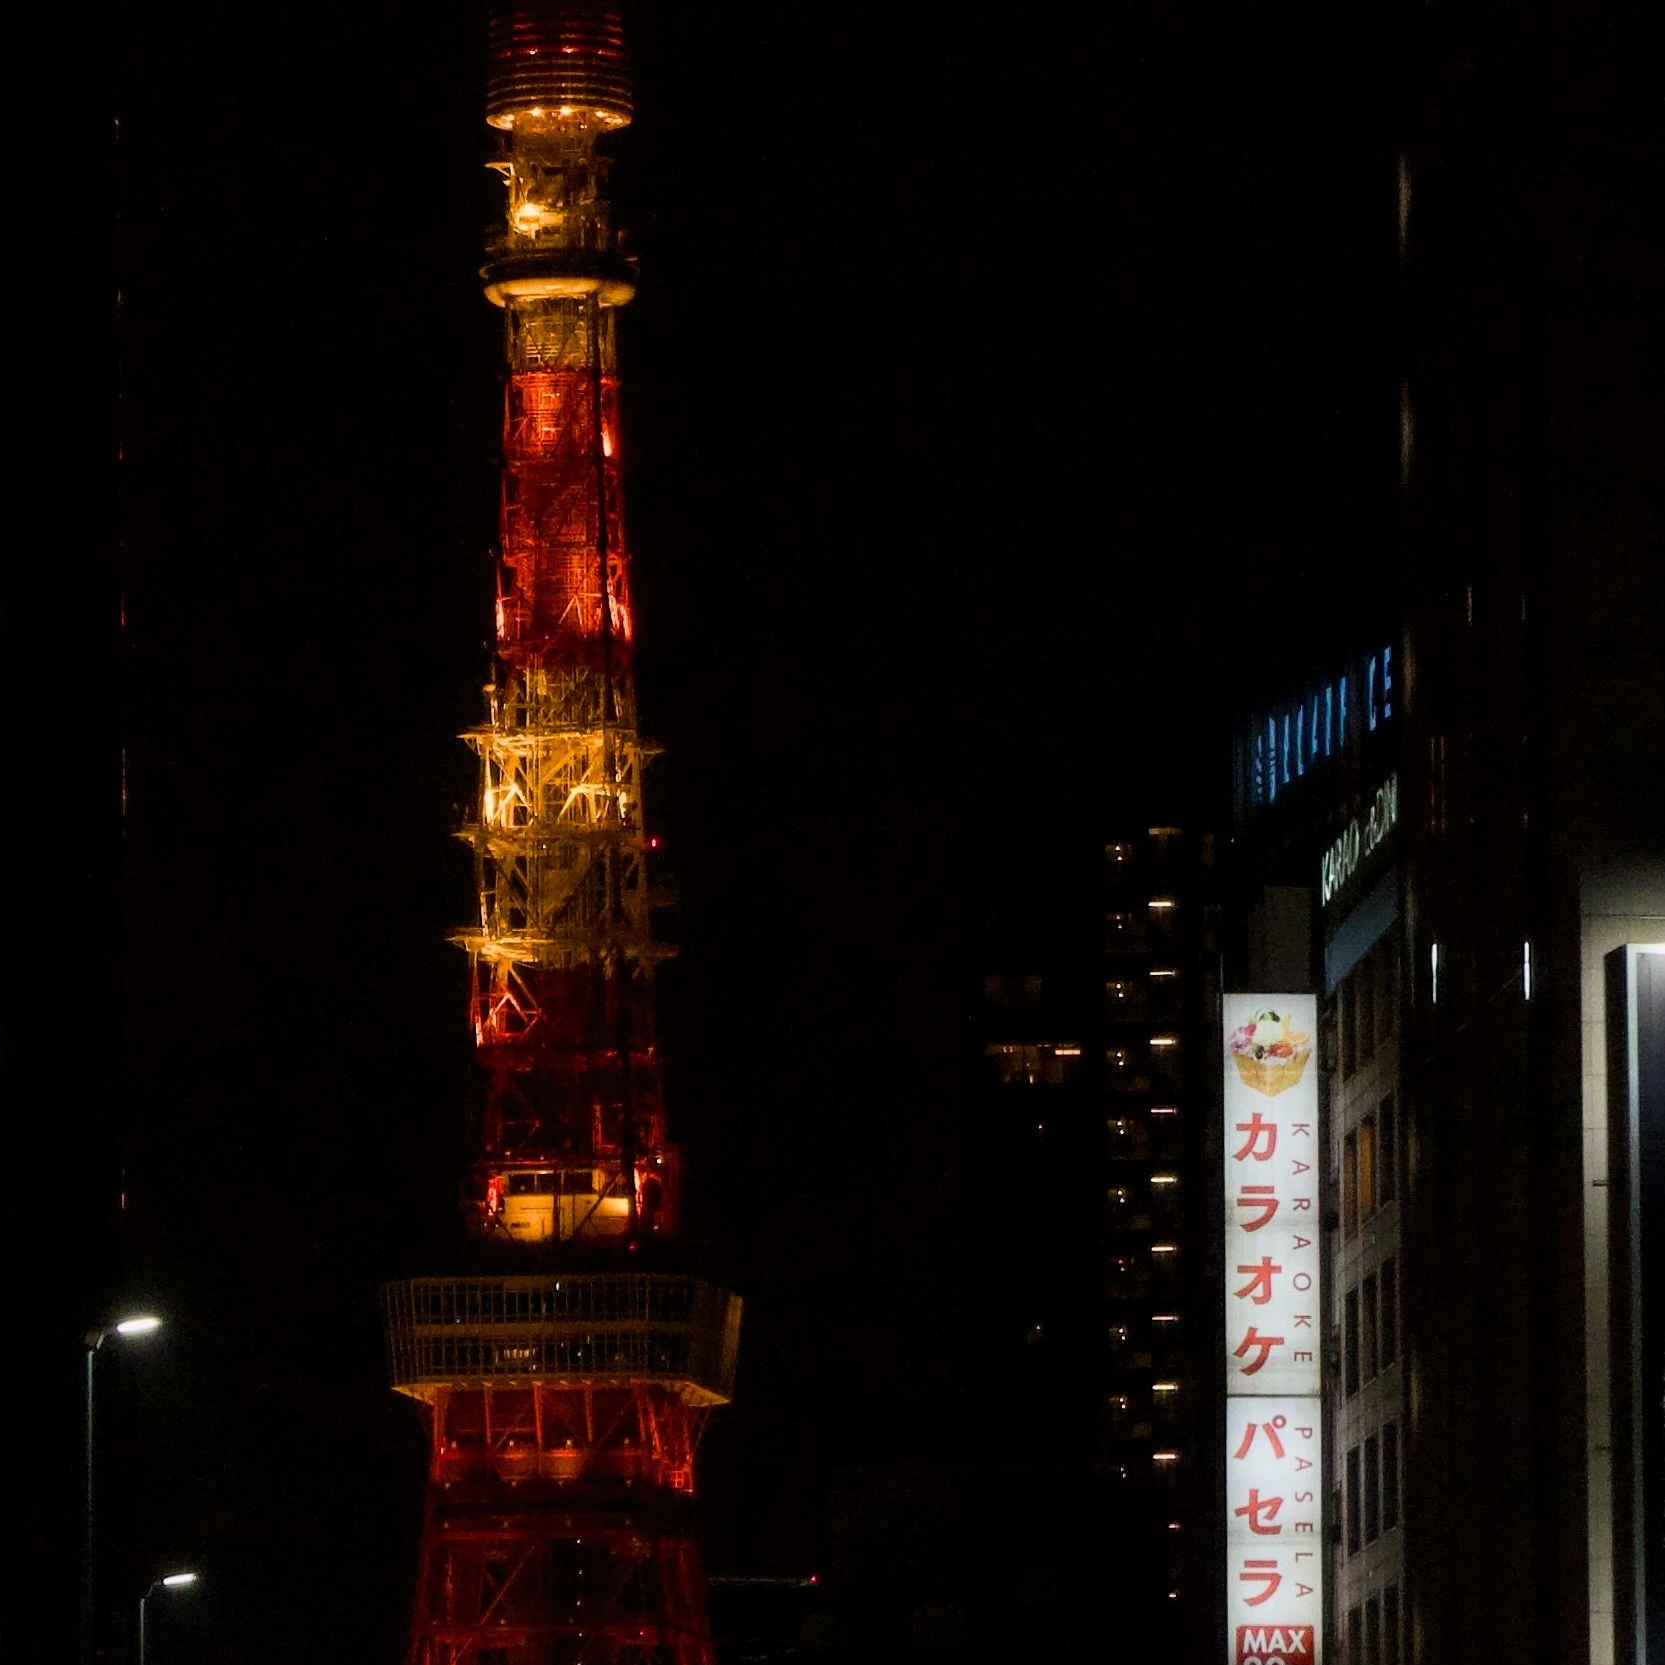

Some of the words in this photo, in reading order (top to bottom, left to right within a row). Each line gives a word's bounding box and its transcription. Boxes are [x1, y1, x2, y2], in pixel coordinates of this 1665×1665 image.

[1232, 1112, 1285, 1376] カラオケ
[1292, 1122, 1313, 1362] KARAOKE
[1234, 1414, 1287, 1607] パセラ
[1294, 1426, 1314, 1598] PASELA
[1243, 1629, 1307, 1654] MAX
